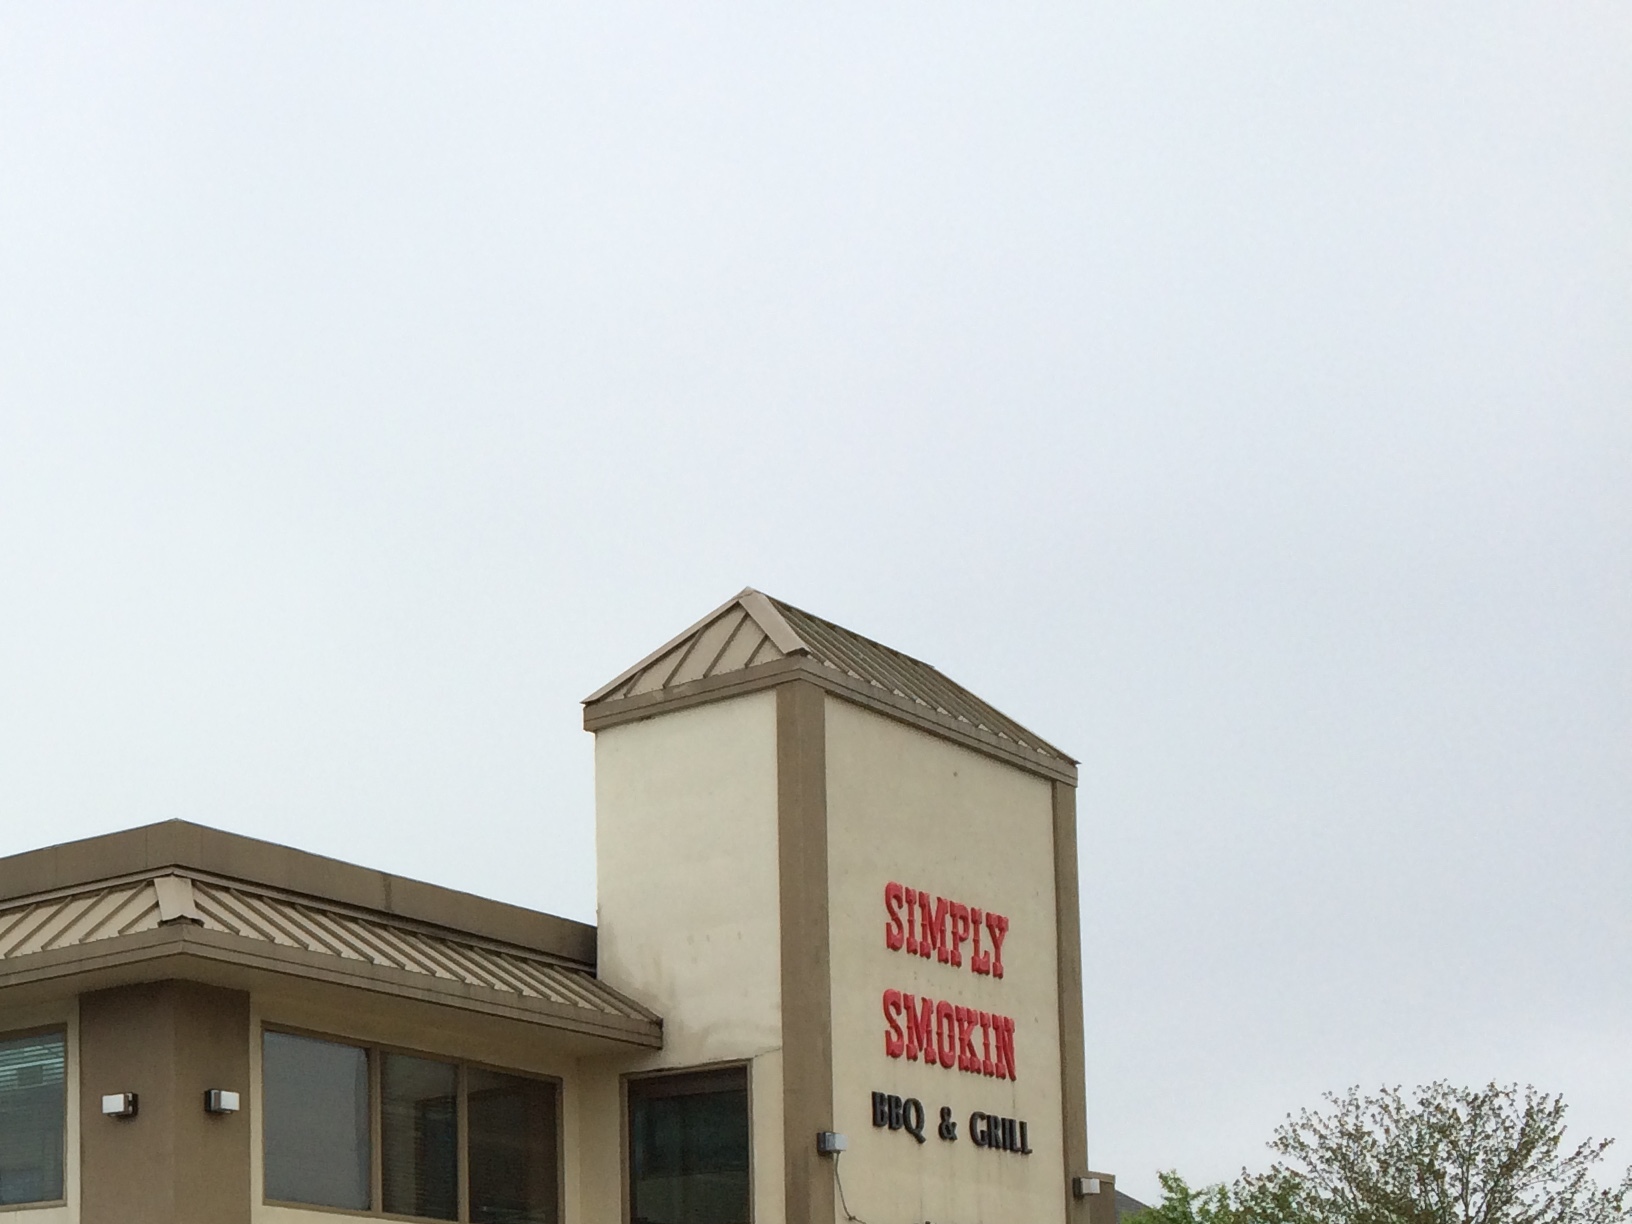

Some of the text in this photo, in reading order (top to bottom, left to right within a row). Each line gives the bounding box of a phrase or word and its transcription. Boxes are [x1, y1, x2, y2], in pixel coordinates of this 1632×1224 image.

[885, 881, 1009, 979] SIMPLY
[883, 989, 1016, 1081] SMOKIN
[871, 1091, 1033, 1155] BBQ & GRILL
